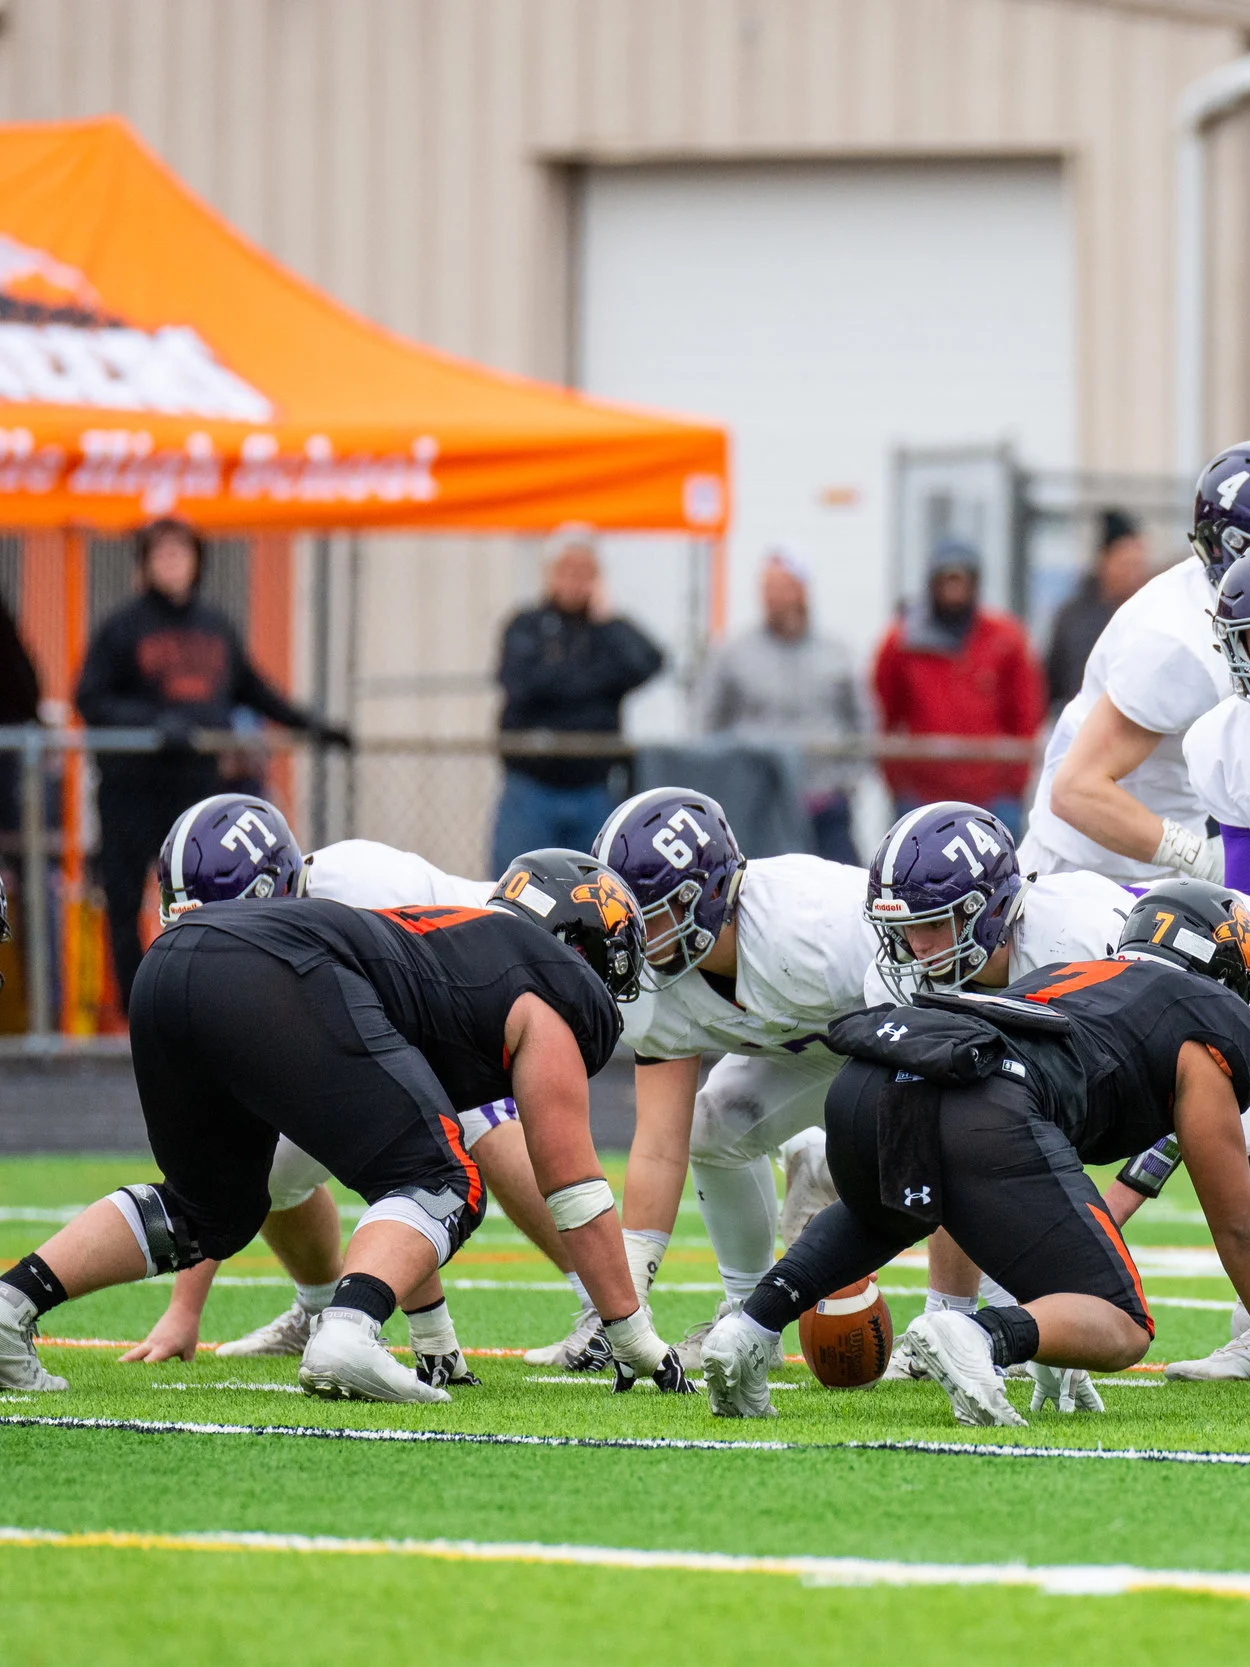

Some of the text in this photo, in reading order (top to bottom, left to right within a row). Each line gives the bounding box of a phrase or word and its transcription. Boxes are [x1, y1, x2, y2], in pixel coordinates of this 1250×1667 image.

[1216, 470, 1250, 511] 4
[220, 810, 277, 865] 77
[652, 808, 711, 870] 67
[941, 821, 1001, 878] 74
[1151, 911, 1175, 944] 7
[1025, 960, 1134, 1004] 7
